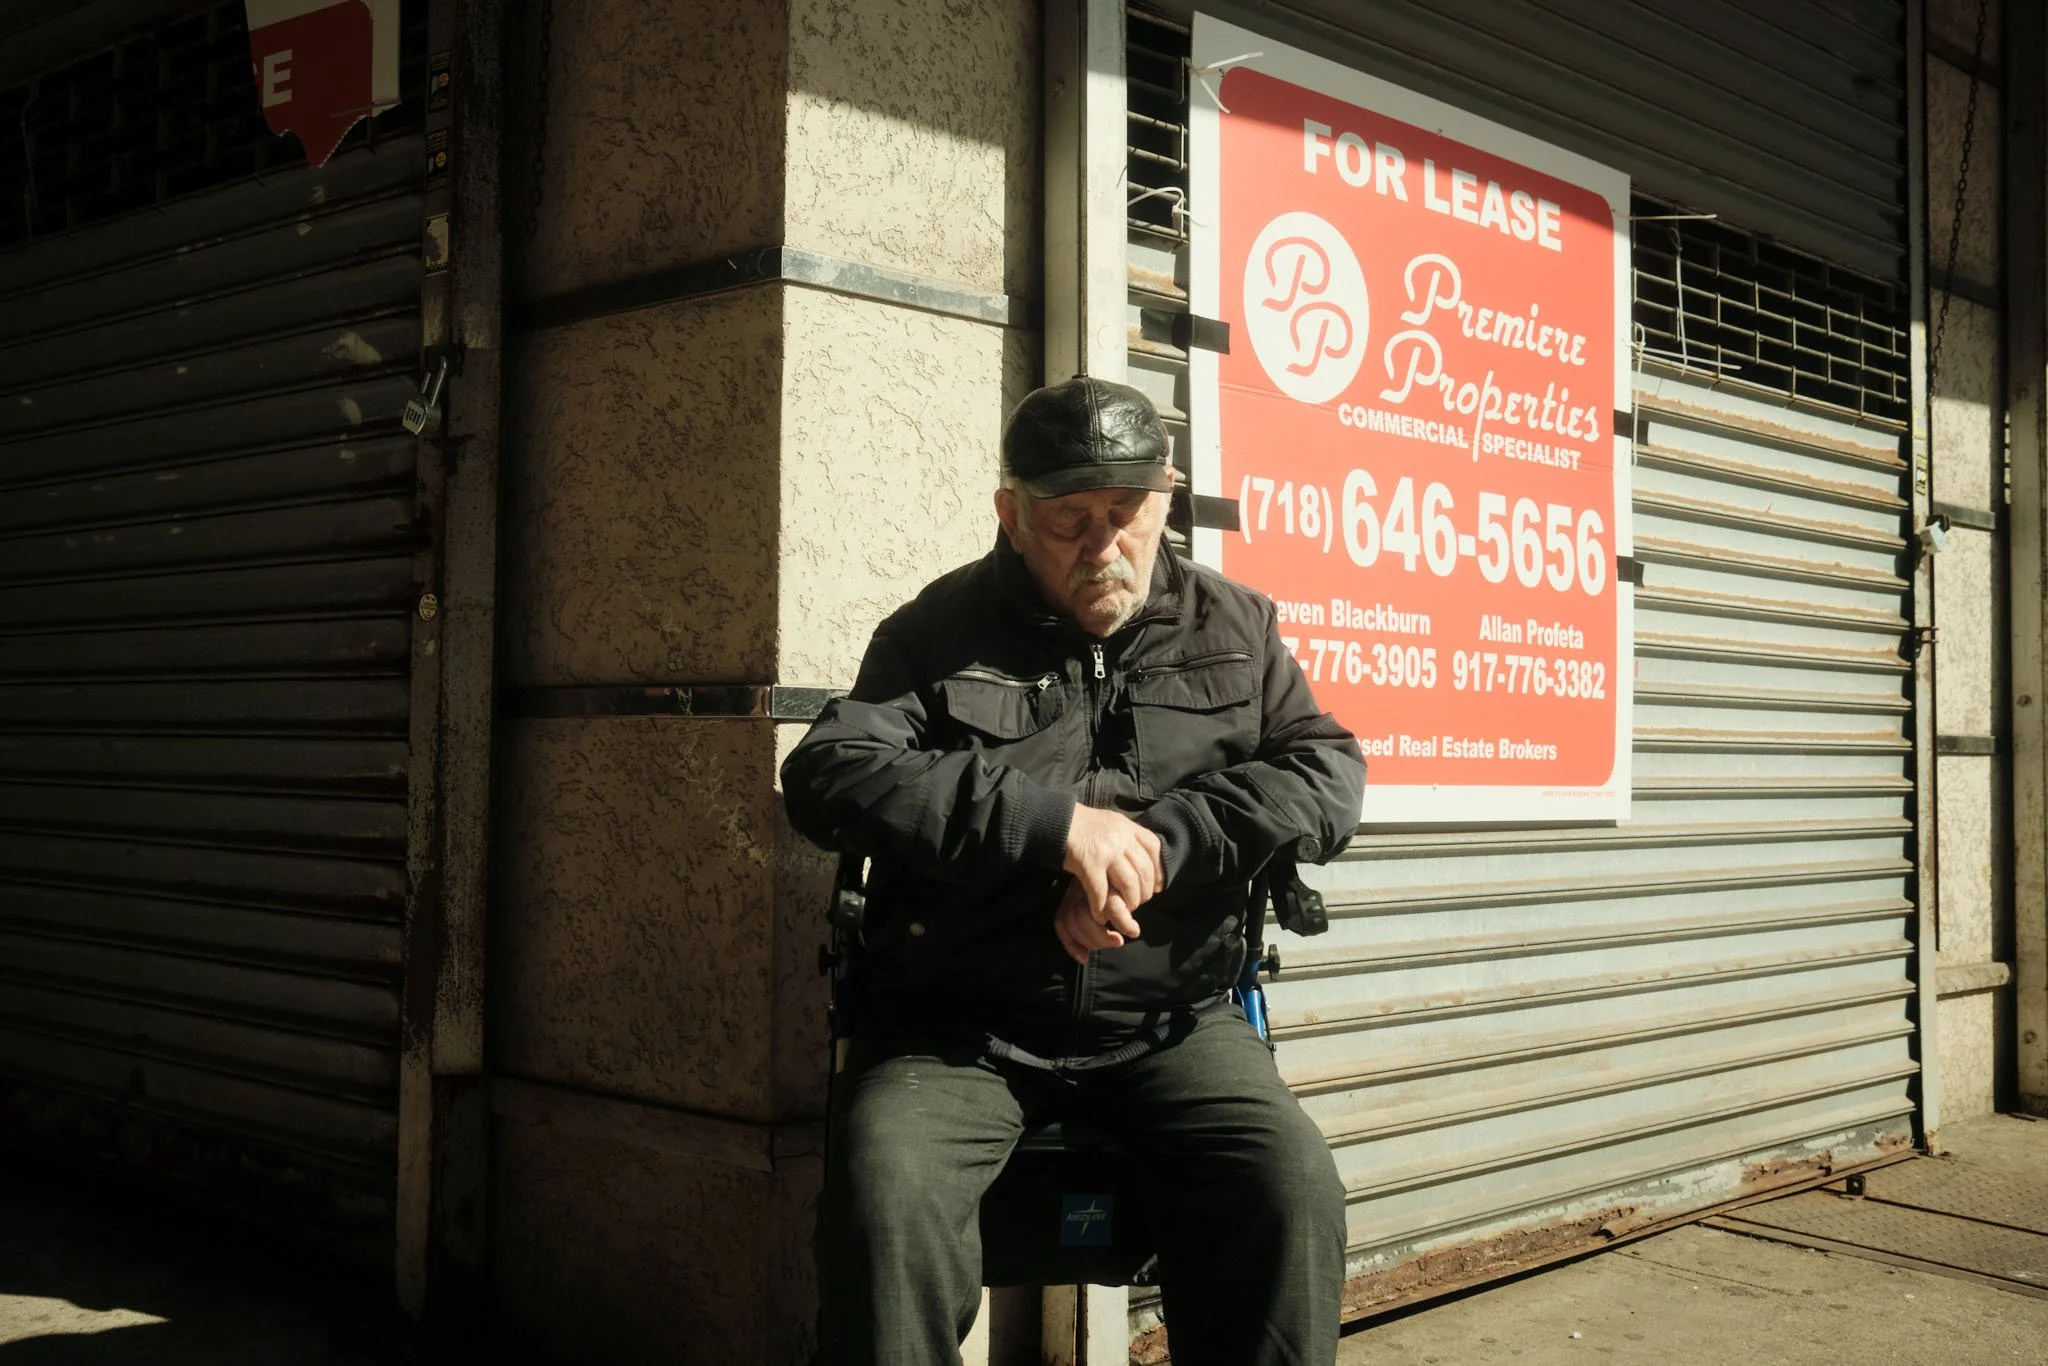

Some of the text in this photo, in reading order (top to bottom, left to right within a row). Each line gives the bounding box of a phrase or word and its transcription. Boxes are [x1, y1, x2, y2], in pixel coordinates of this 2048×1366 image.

[253, 48, 294, 109] E
[1303, 119, 1563, 252] FOR LEASE
[1400, 253, 1586, 366] Premiere
[1379, 329, 1600, 463] Properties
[1338, 403, 1582, 471] COMMERCIAL SPECIALIST
[1239, 469, 1607, 597] (718) 646-5656
[1267, 593, 1431, 636] even Blackburn
[1479, 614, 1584, 650] Allan Profeta
[1280, 636, 1438, 689] 7-776-3905
[1453, 650, 1605, 700] 917-776-3382
[1399, 735, 1438, 758] Real
[1442, 736, 1495, 759] Estate
[1499, 739, 1558, 761] Brokers
